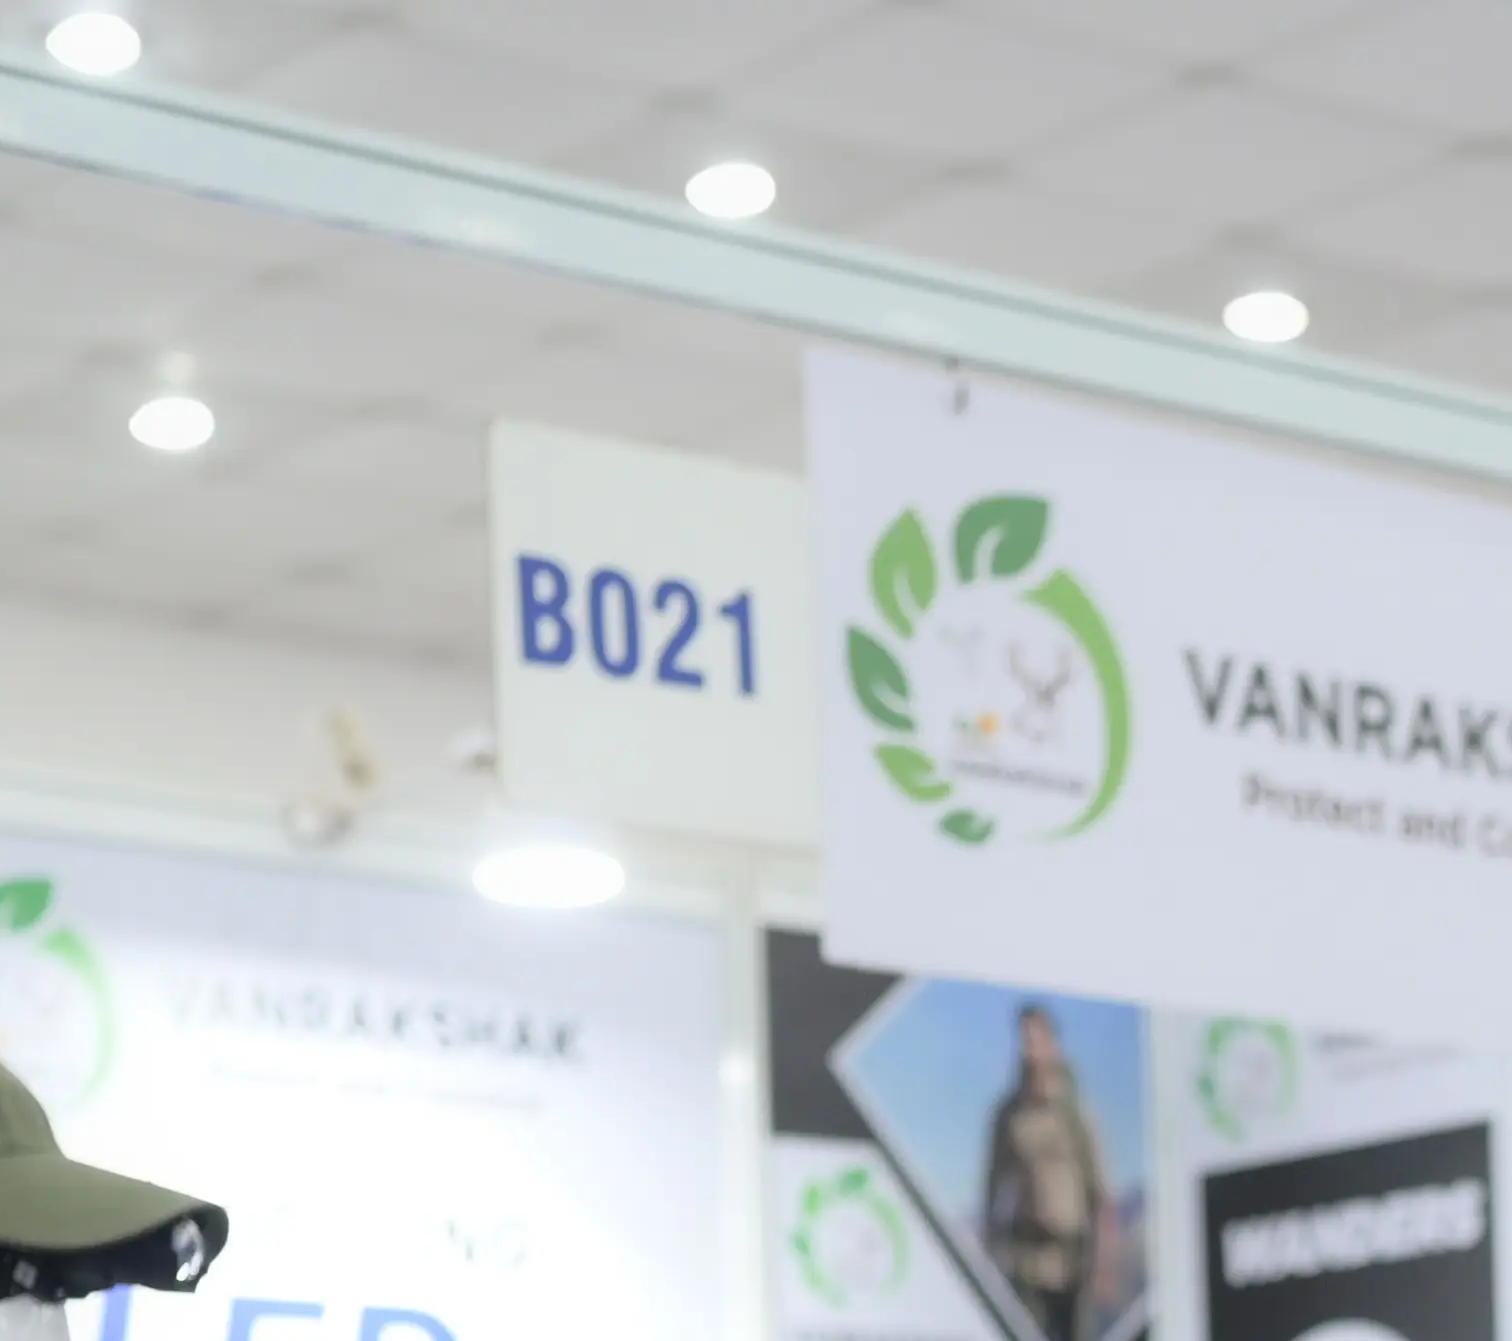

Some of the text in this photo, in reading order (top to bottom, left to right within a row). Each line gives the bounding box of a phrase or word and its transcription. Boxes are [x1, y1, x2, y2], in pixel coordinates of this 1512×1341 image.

[515, 552, 756, 697] B021
[1240, 772, 1387, 836] Protect
[1399, 807, 1467, 851] and
